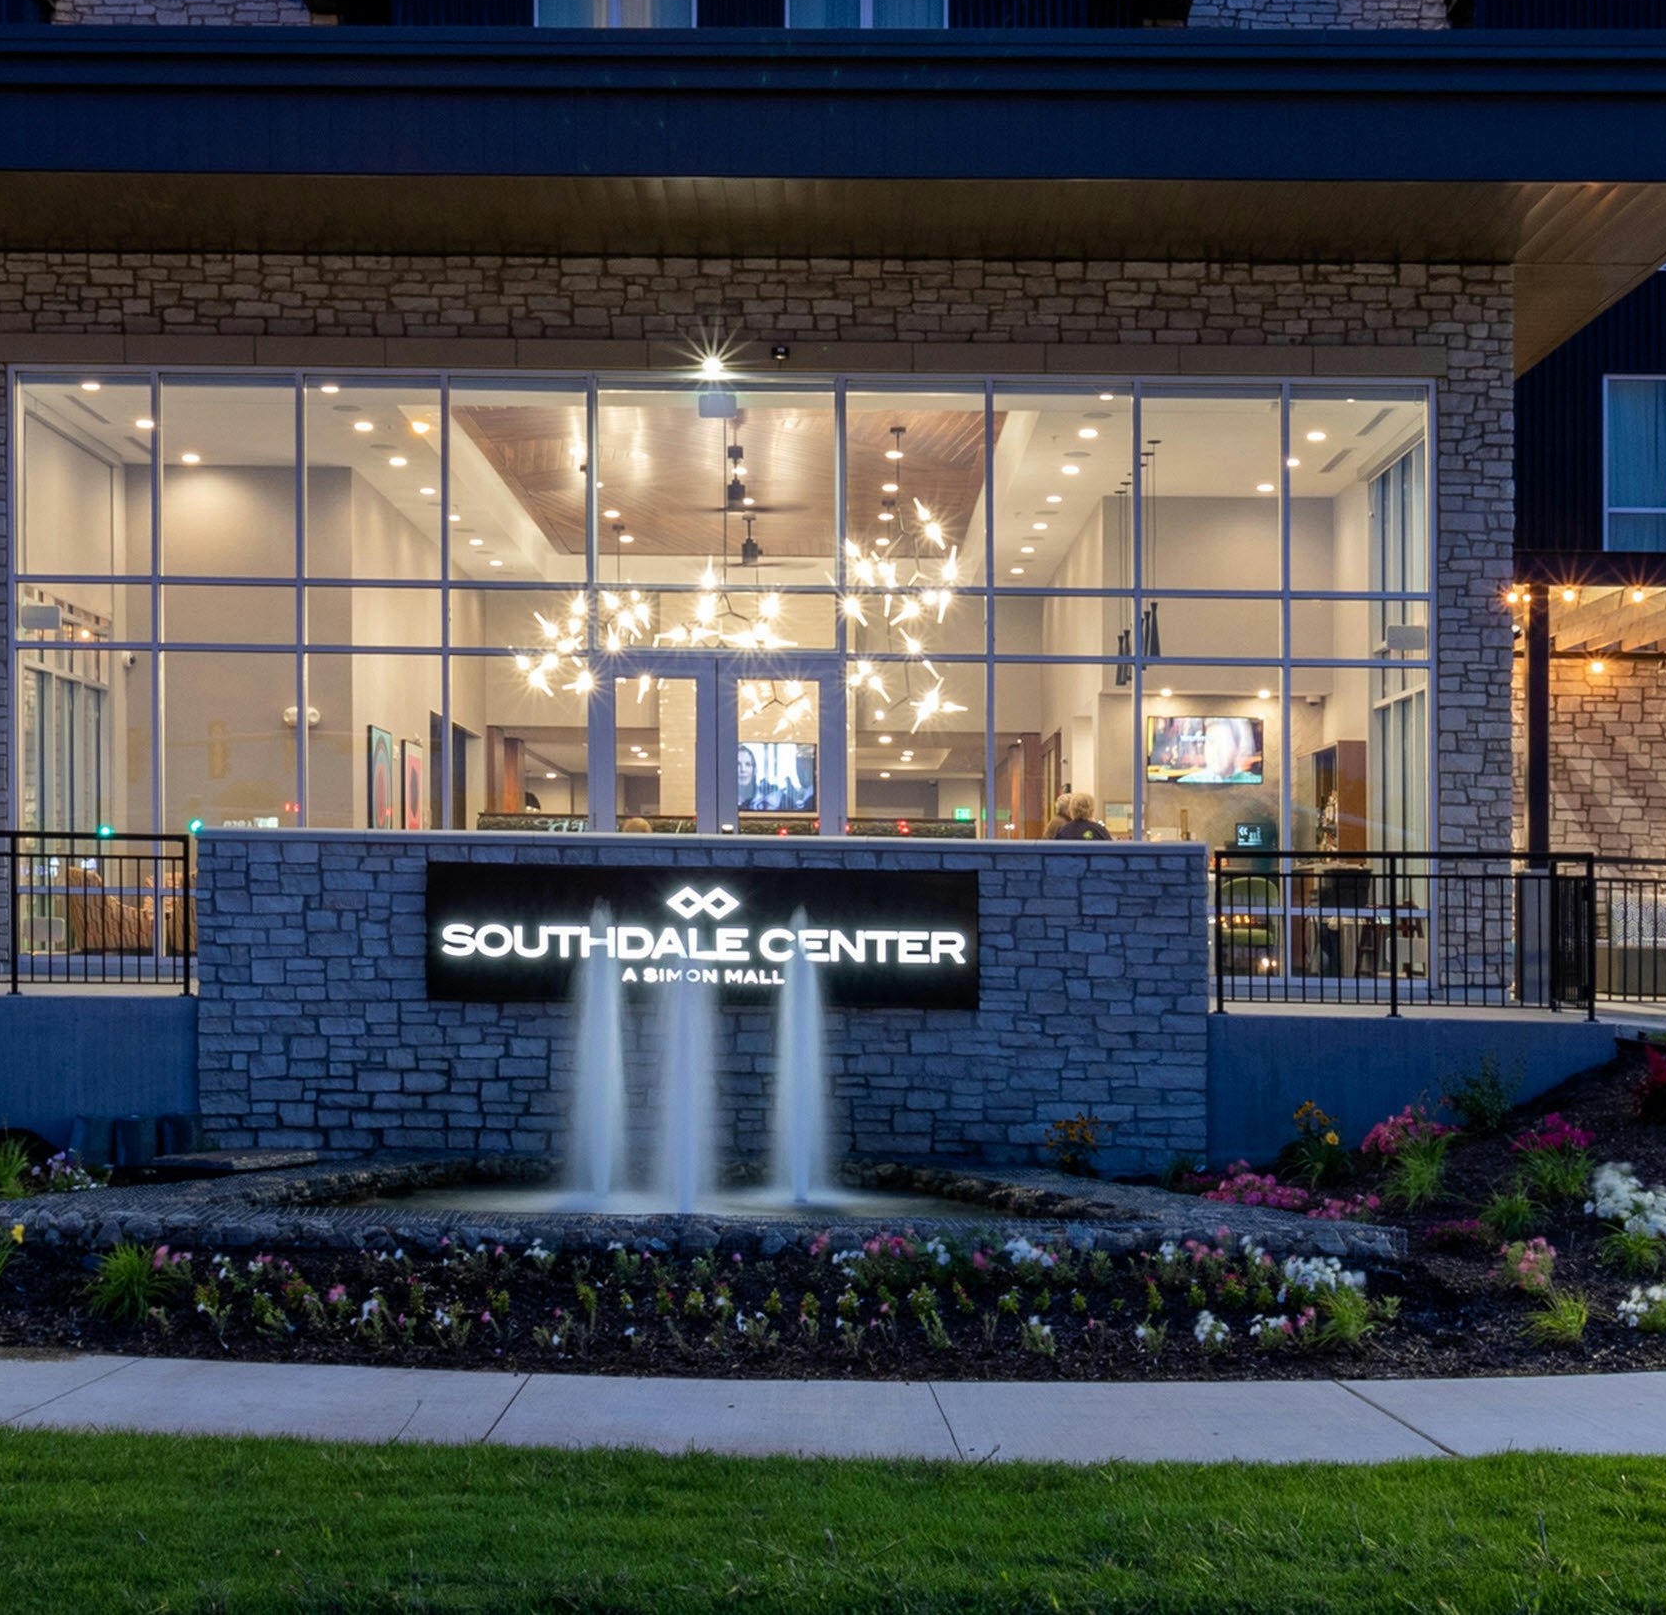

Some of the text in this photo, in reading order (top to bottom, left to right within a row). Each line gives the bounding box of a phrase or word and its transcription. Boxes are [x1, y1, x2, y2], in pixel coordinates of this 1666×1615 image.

[441, 923, 967, 964] SOUTHDALE CENTER
[621, 967, 786, 985] A SIMON MALL
